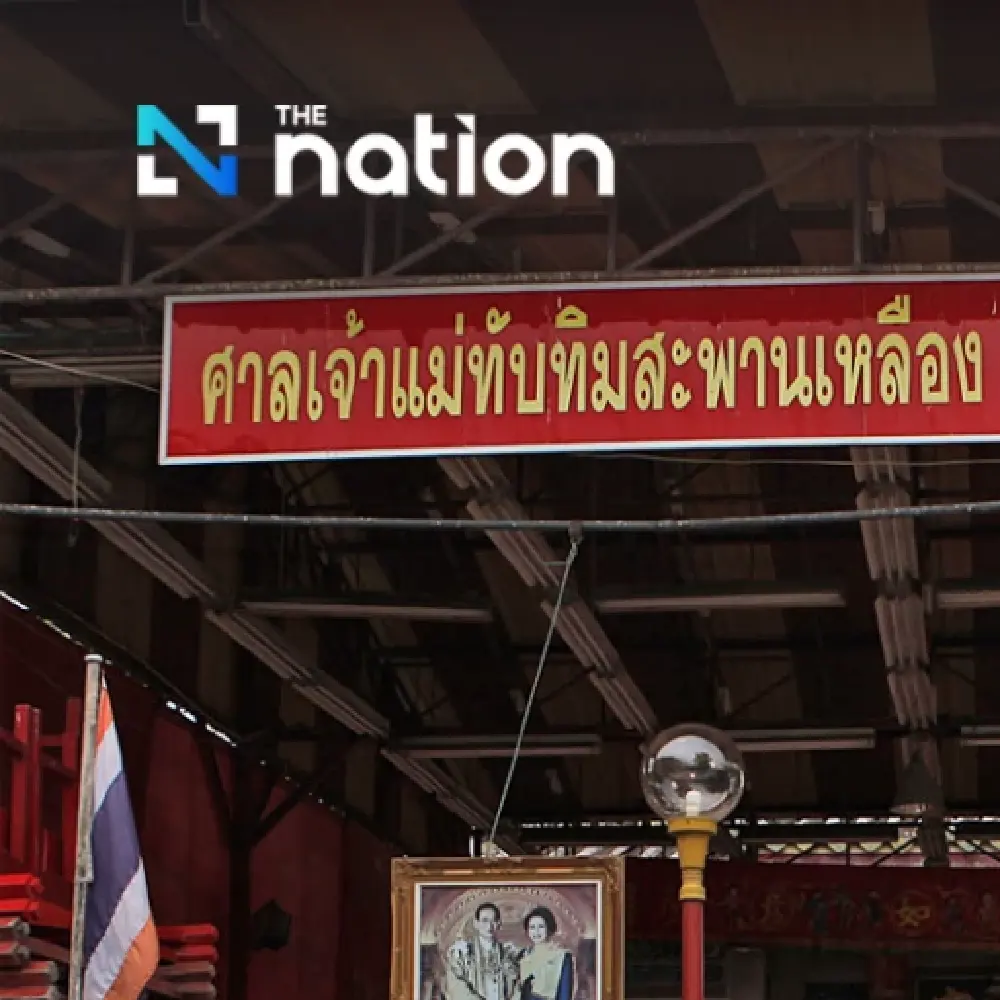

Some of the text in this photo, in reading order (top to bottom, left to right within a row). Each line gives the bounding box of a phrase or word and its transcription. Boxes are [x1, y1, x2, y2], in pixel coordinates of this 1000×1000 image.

[201, 294, 985, 426] ศาลเจ้าแม่ทับทิมสะพานเหลือง
